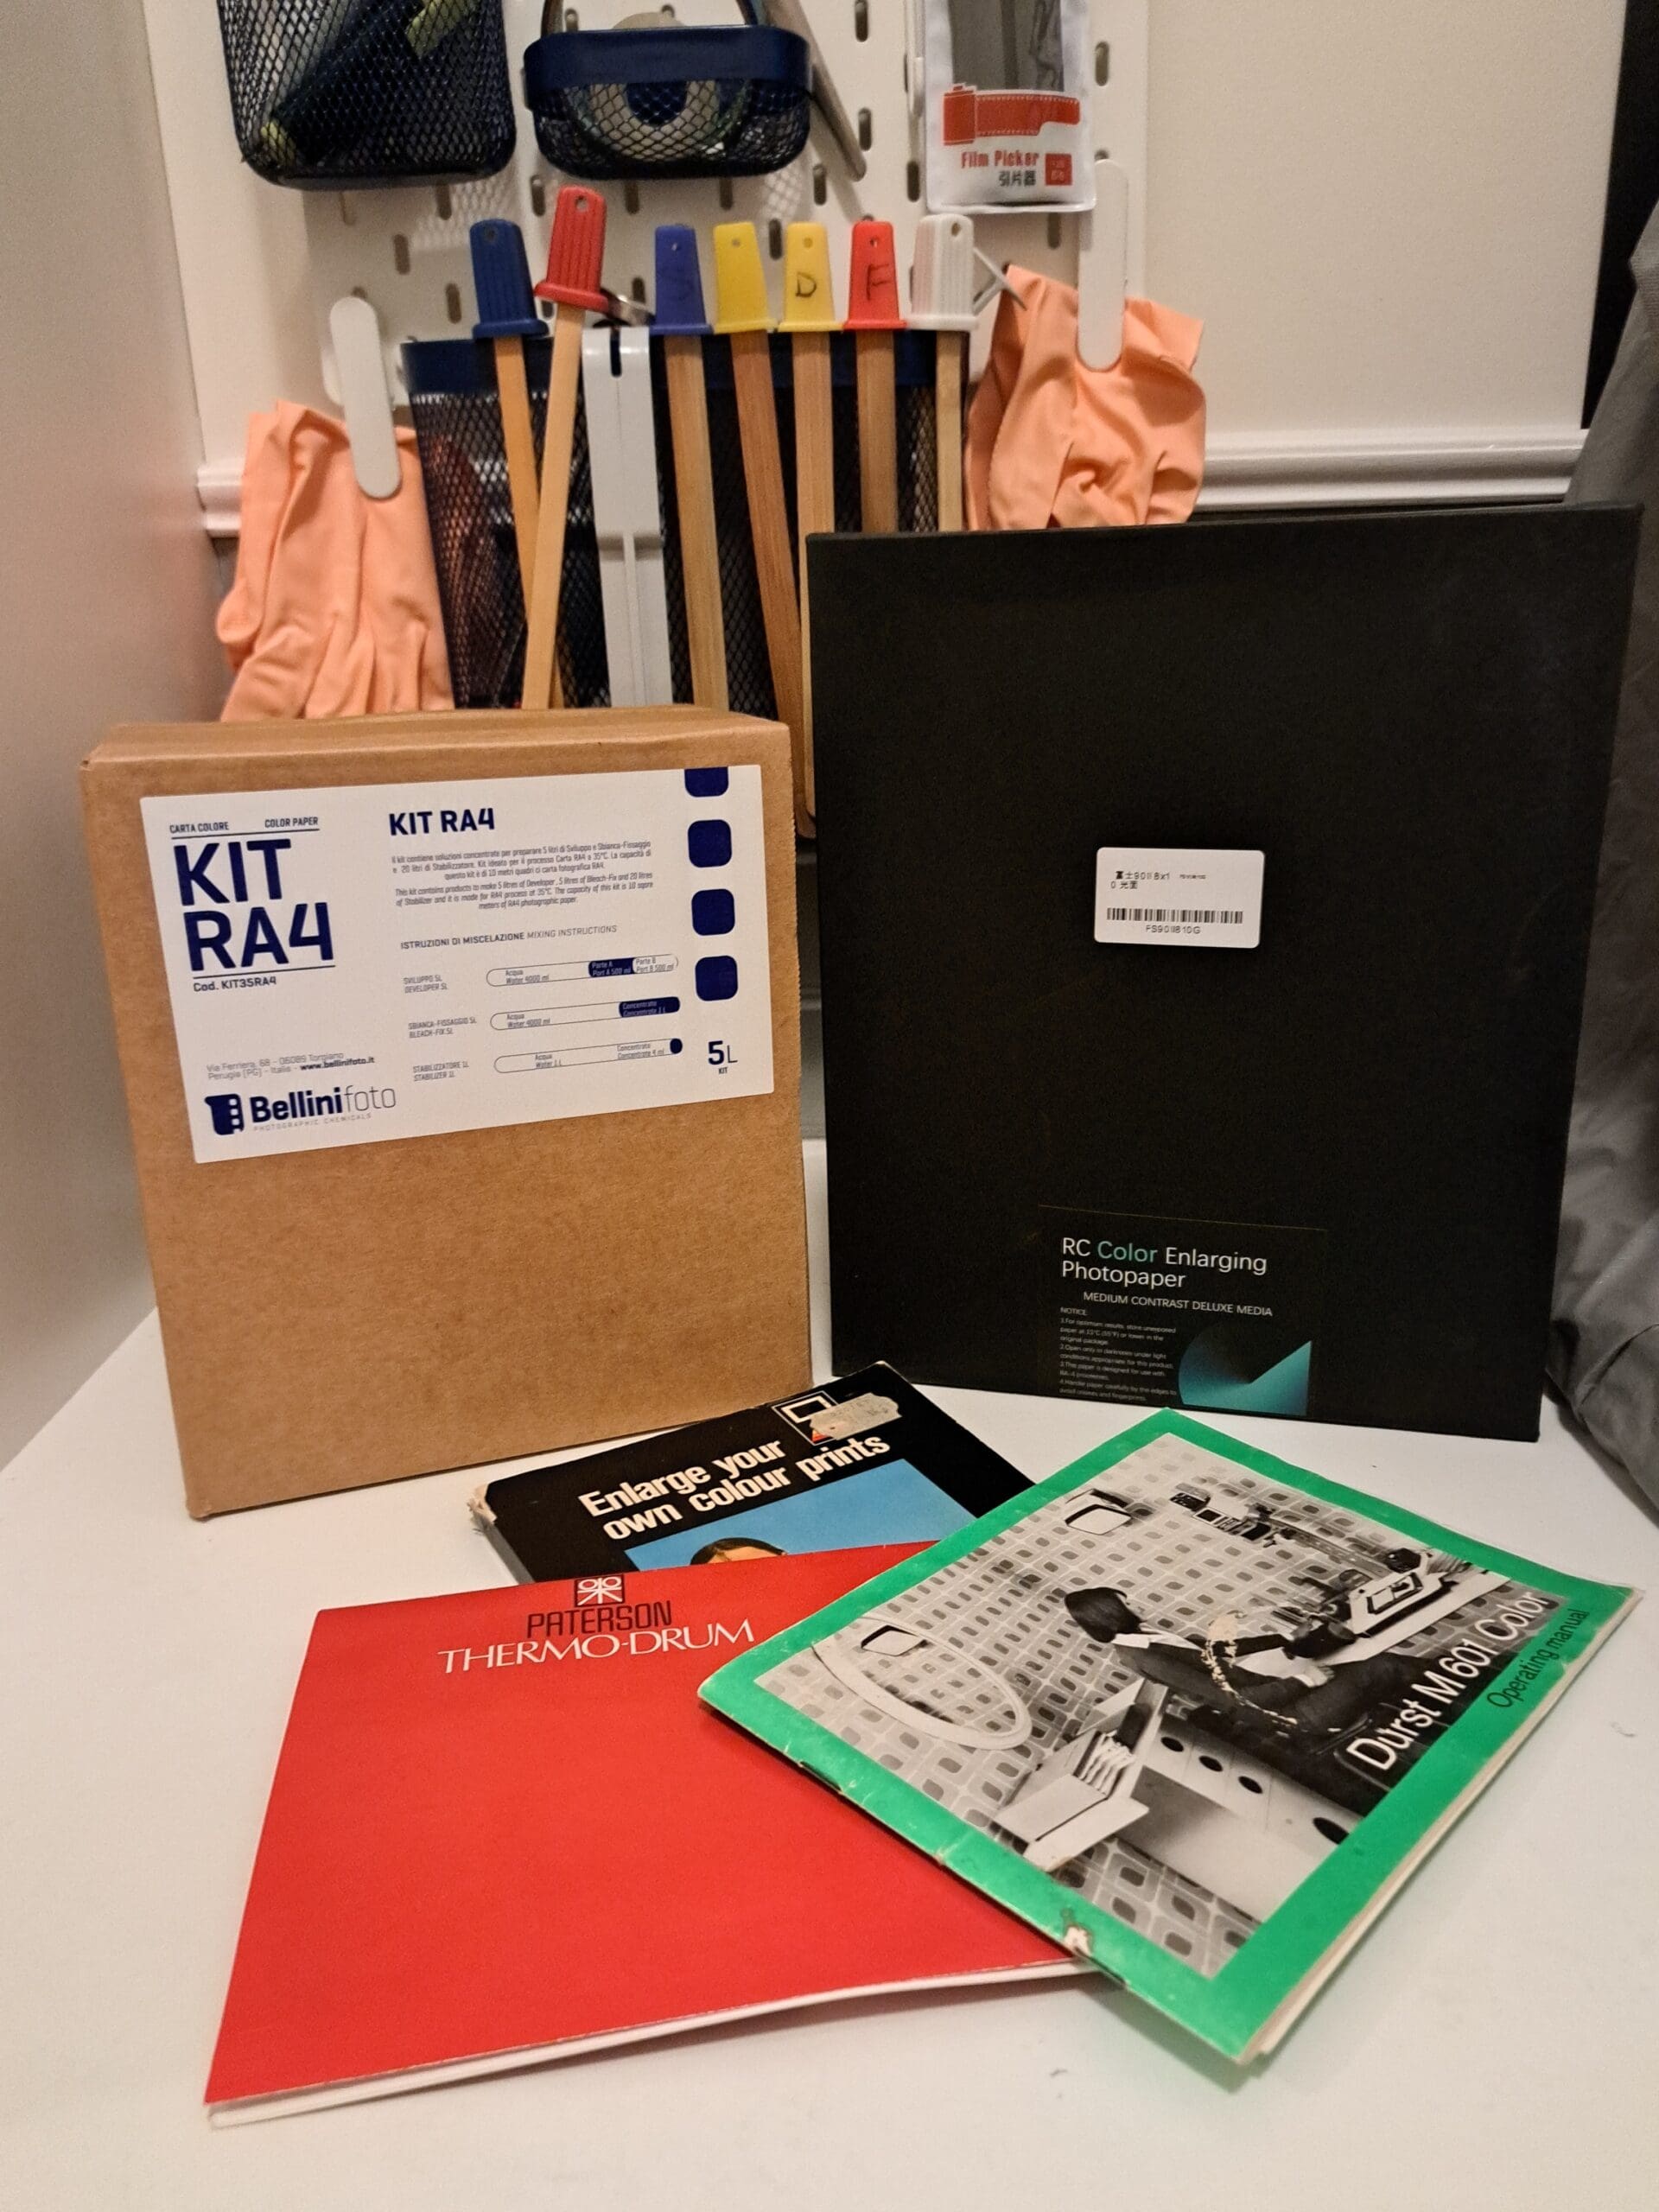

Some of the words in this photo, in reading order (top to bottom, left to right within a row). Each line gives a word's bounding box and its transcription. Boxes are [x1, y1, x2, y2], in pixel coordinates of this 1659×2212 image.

[961, 151, 989, 168] Film
[995, 149, 1039, 167] Picker
[795, 271, 817, 298] D
[865, 263, 890, 301] F
[169, 824, 195, 834] CARTA
[197, 822, 230, 832] COLORE
[264, 817, 291, 829] COLOR
[292, 817, 319, 827] PAPER
[389, 810, 433, 836] KIT
[440, 807, 495, 833] RA4
[173, 838, 291, 906] KIT
[183, 901, 334, 972] RA4
[401, 938, 449, 950] ISTRUZIONI
[463, 932, 524, 944] MISCELAZIONE
[527, 930, 556, 939] MIXING
[558, 925, 617, 937] INSTRUCTIONS
[193, 982, 219, 993] Cod.
[221, 976, 277, 990] KIT35RA4
[301, 1056, 375, 1071] www.bellinifoto.it
[708, 1039, 739, 1065] 5L
[718, 1066, 728, 1075] KIT
[249, 1084, 397, 1124] Bellinifoto
[1062, 1237, 1091, 1256] RC
[1096, 1241, 1158, 1262] Color
[1166, 1247, 1268, 1276] Enlarging
[1062, 1261, 1186, 1289] Photopaper
[1083, 1291, 1128, 1305] MEDIUM
[1131, 1295, 1190, 1310] CONTRAST
[1192, 1300, 1234, 1313] DELUXE
[1236, 1305, 1273, 1317] MEDIA
[578, 1465, 711, 1517] Enlarge
[713, 1439, 787, 1479] your
[603, 1503, 683, 1541] own
[689, 1467, 791, 1512] colour
[796, 1436, 891, 1482] prints
[527, 1600, 672, 1638] PATERSON
[438, 1618, 755, 1674] THERMO-DRUM
[1487, 1646, 1554, 1709] Operating
[1548, 1608, 1590, 1660] manual
[1346, 1698, 1442, 1770] Durst
[1411, 1669, 1467, 1705] M
[1439, 1638, 1501, 1679] 601
[1474, 1592, 1551, 1642] Color
